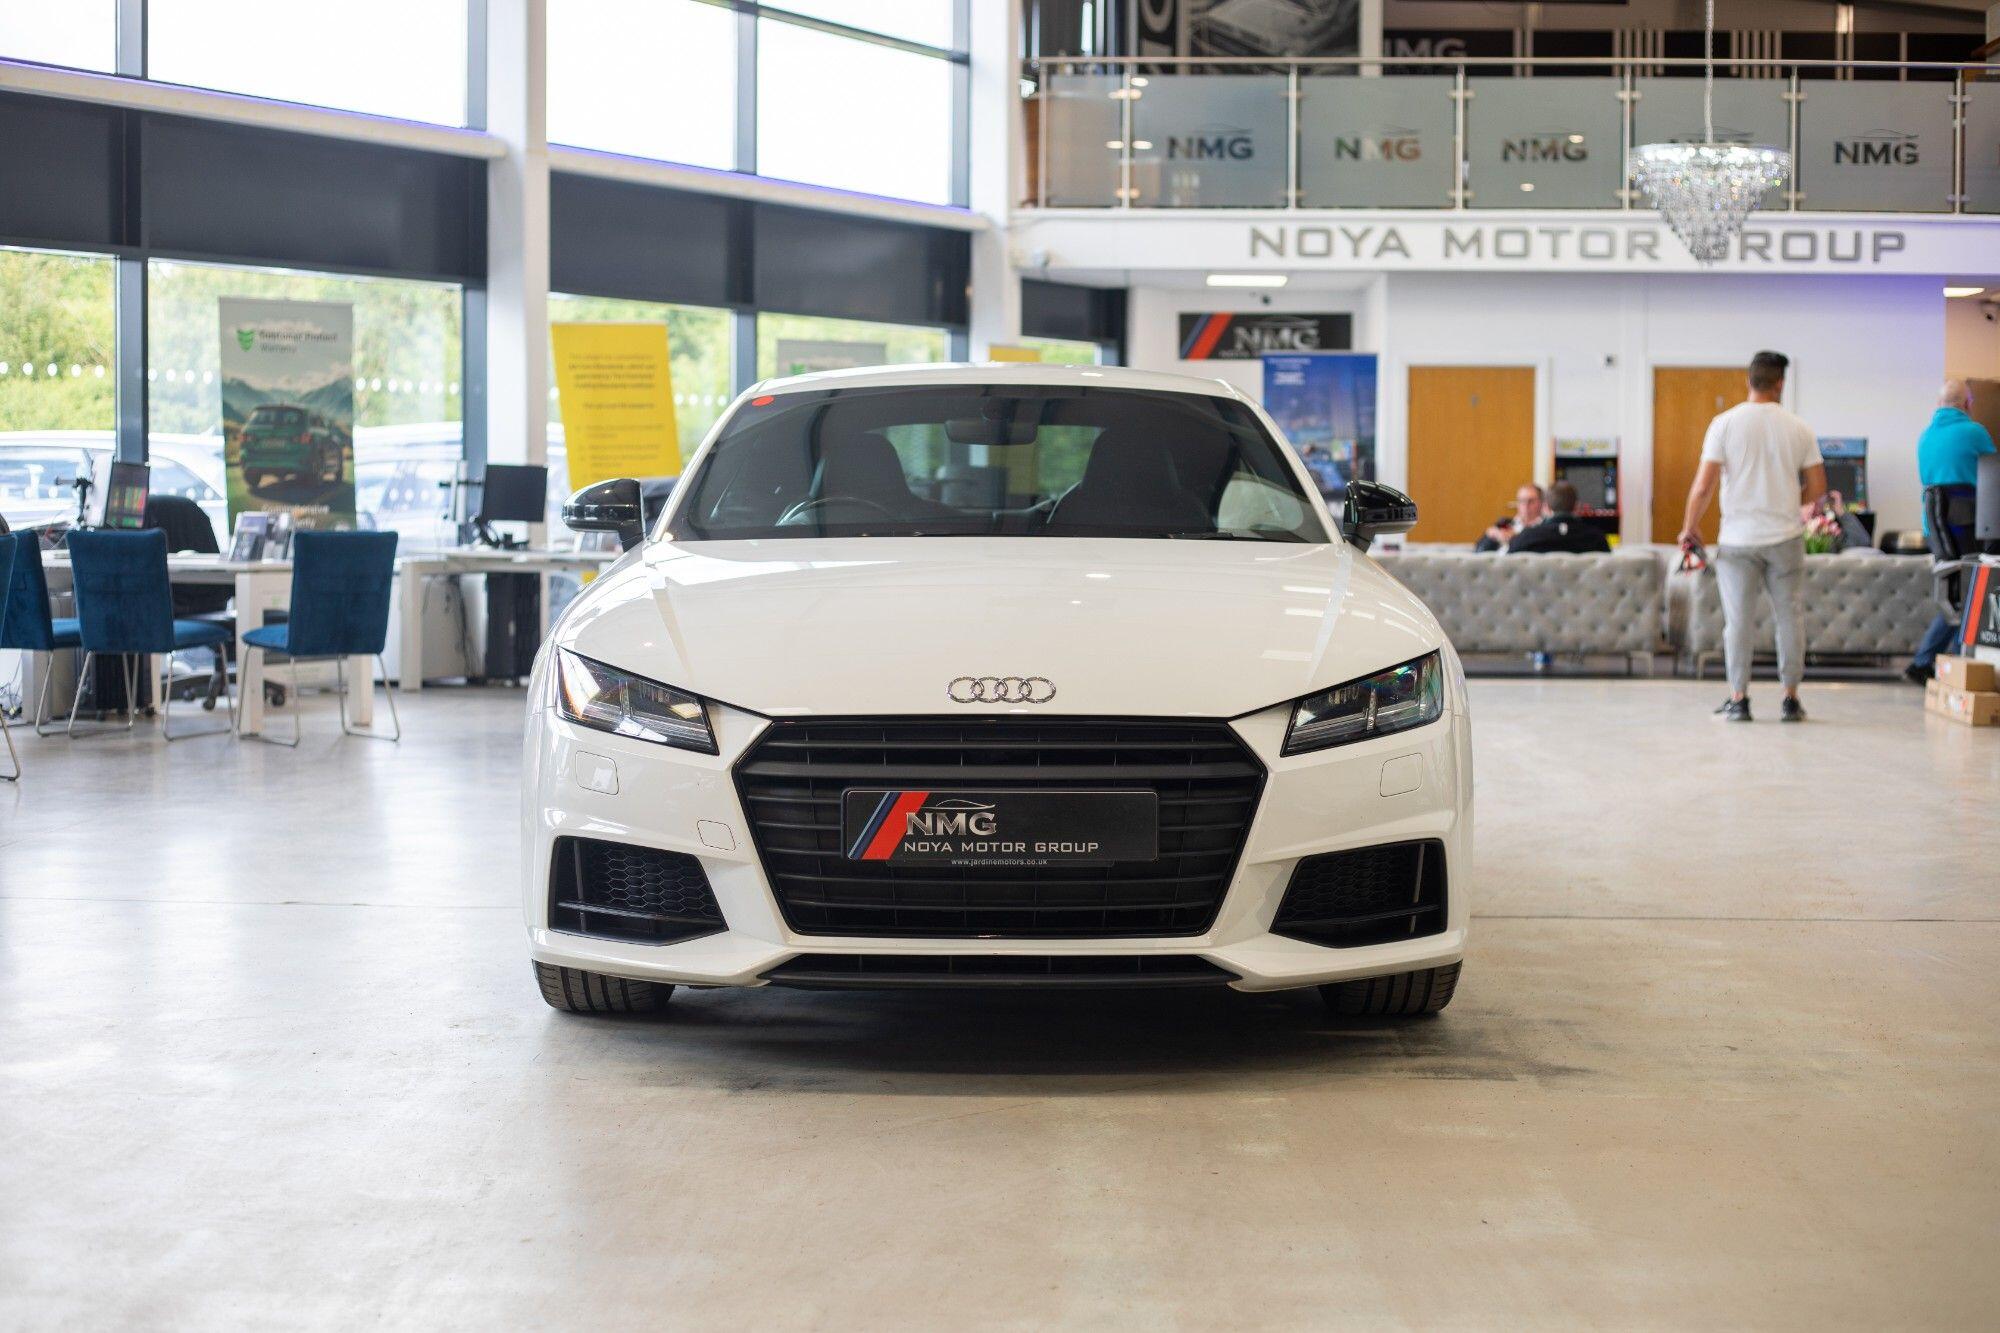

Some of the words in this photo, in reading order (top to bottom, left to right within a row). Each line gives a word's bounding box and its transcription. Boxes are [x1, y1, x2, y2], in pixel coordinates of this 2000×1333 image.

[1167, 136, 1254, 161] NMG
[1502, 136, 1589, 163] NMG
[1834, 140, 1920, 165] NMG
[1249, 226, 1412, 259] NOYA
[1442, 226, 1661, 260] MOTOR
[1233, 325, 1321, 350] NMG
[905, 812, 997, 836] NMG
[904, 842, 952, 852] NOYA
[961, 842, 1026, 853] MOTOR
[1034, 842, 1099, 853] GROUP
[951, 858, 1048, 867] www.jardinemotors.co.uk
